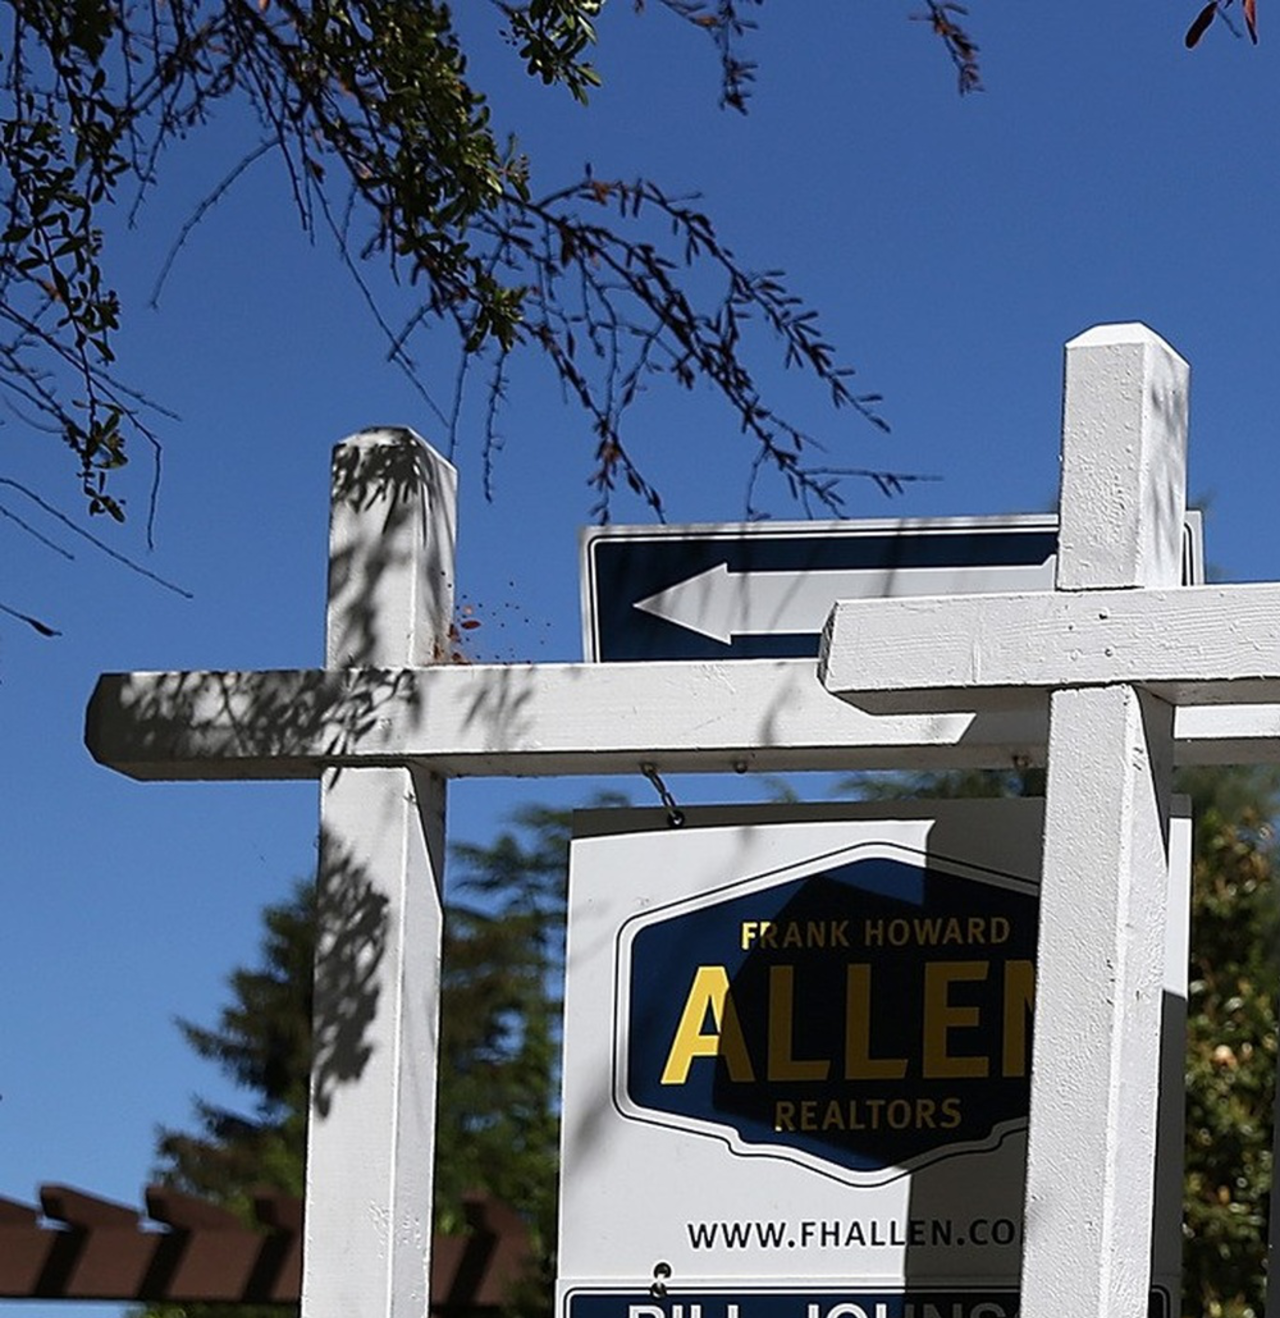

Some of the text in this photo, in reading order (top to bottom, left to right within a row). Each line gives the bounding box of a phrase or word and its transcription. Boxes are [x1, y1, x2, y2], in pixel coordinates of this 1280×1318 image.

[741, 917, 1012, 951] FRANK HOWARD
[774, 1098, 963, 1133] REALTORS
[687, 1218, 1024, 1250] WWW.FHALLEN.CO
